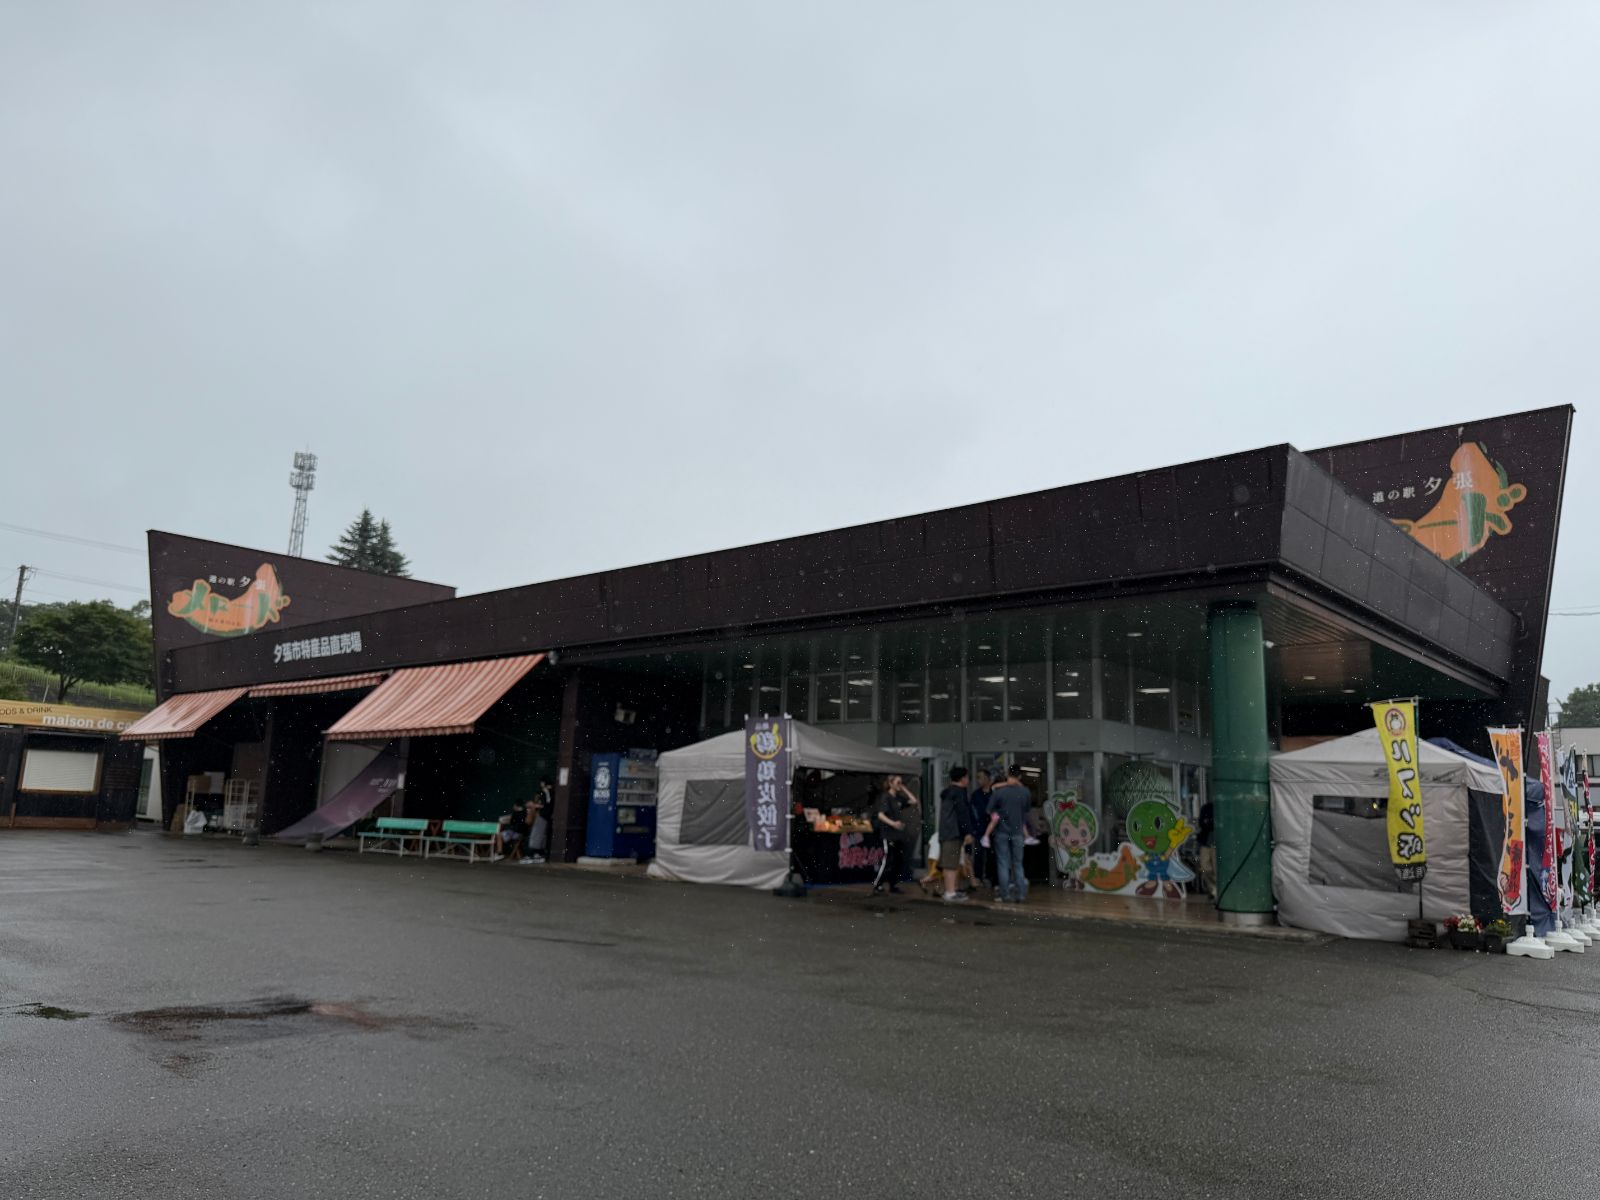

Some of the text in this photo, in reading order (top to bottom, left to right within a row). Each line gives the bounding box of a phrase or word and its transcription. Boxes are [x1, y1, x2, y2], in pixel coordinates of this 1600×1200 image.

[1372, 471, 1474, 504] 道の駅 夕張
[273, 630, 363, 664] 夕張市特産品直売場
[26, 706, 53, 714] DRINK
[42, 713, 94, 728] maison
[96, 716, 114, 730] de
